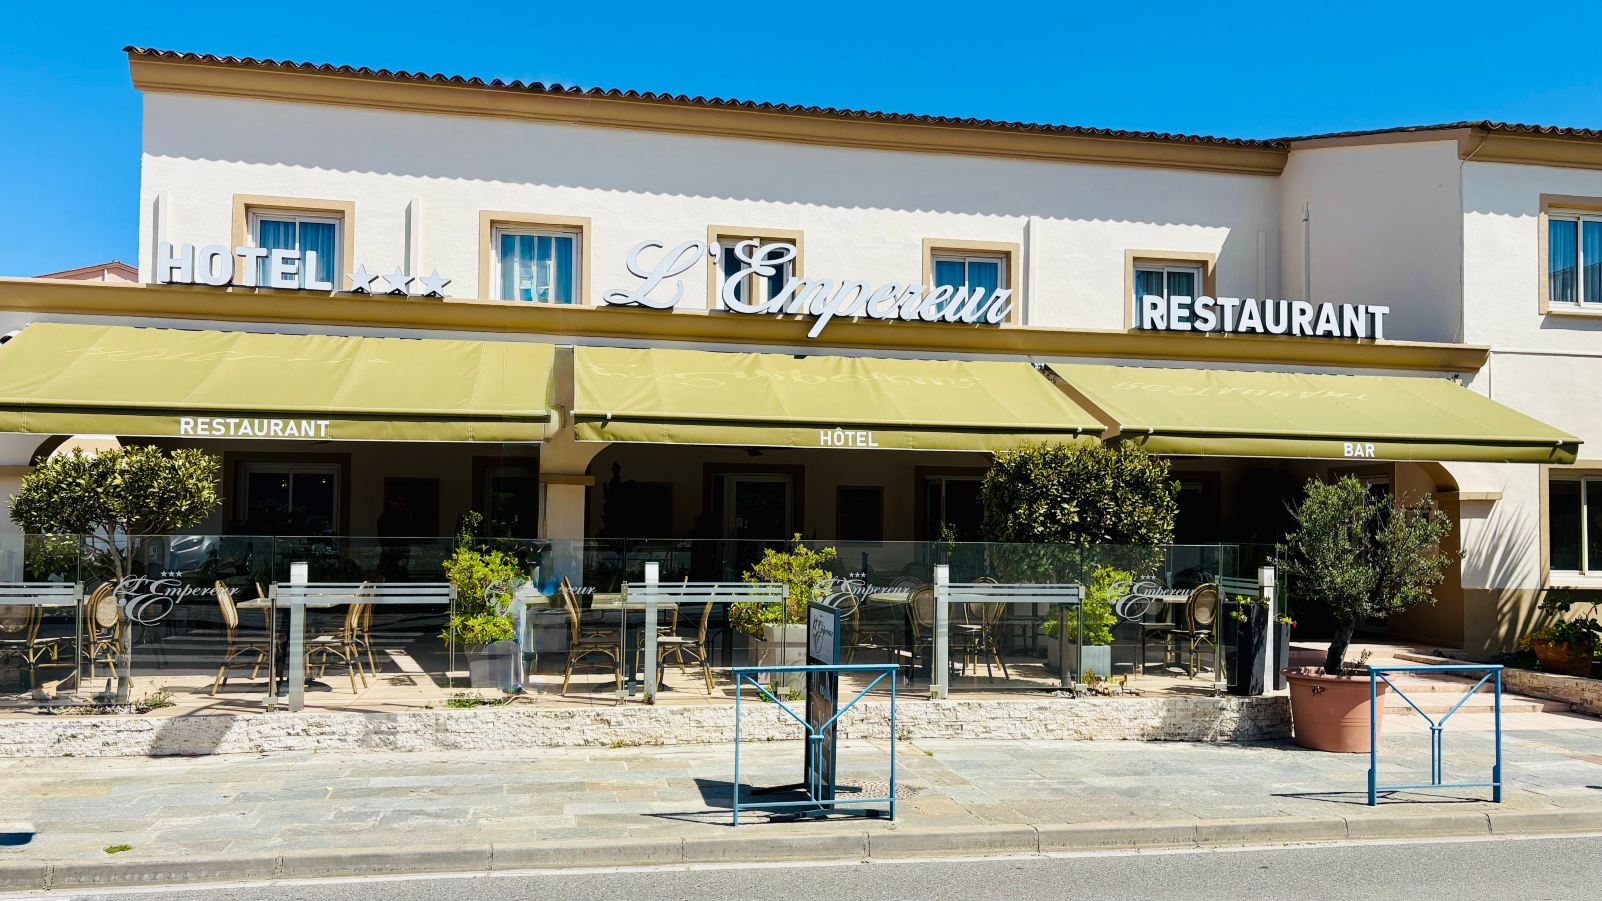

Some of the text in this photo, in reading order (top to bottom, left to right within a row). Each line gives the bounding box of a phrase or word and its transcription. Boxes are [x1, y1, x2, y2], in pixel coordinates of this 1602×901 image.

[159, 242, 332, 290] HOTEL
[603, 239, 1014, 338] L'Empereur
[1142, 295, 1390, 339] RESTAURANT
[180, 417, 330, 438] RESTAURANT
[820, 427, 879, 448] HÔTEL
[1344, 442, 1376, 458] BAR
